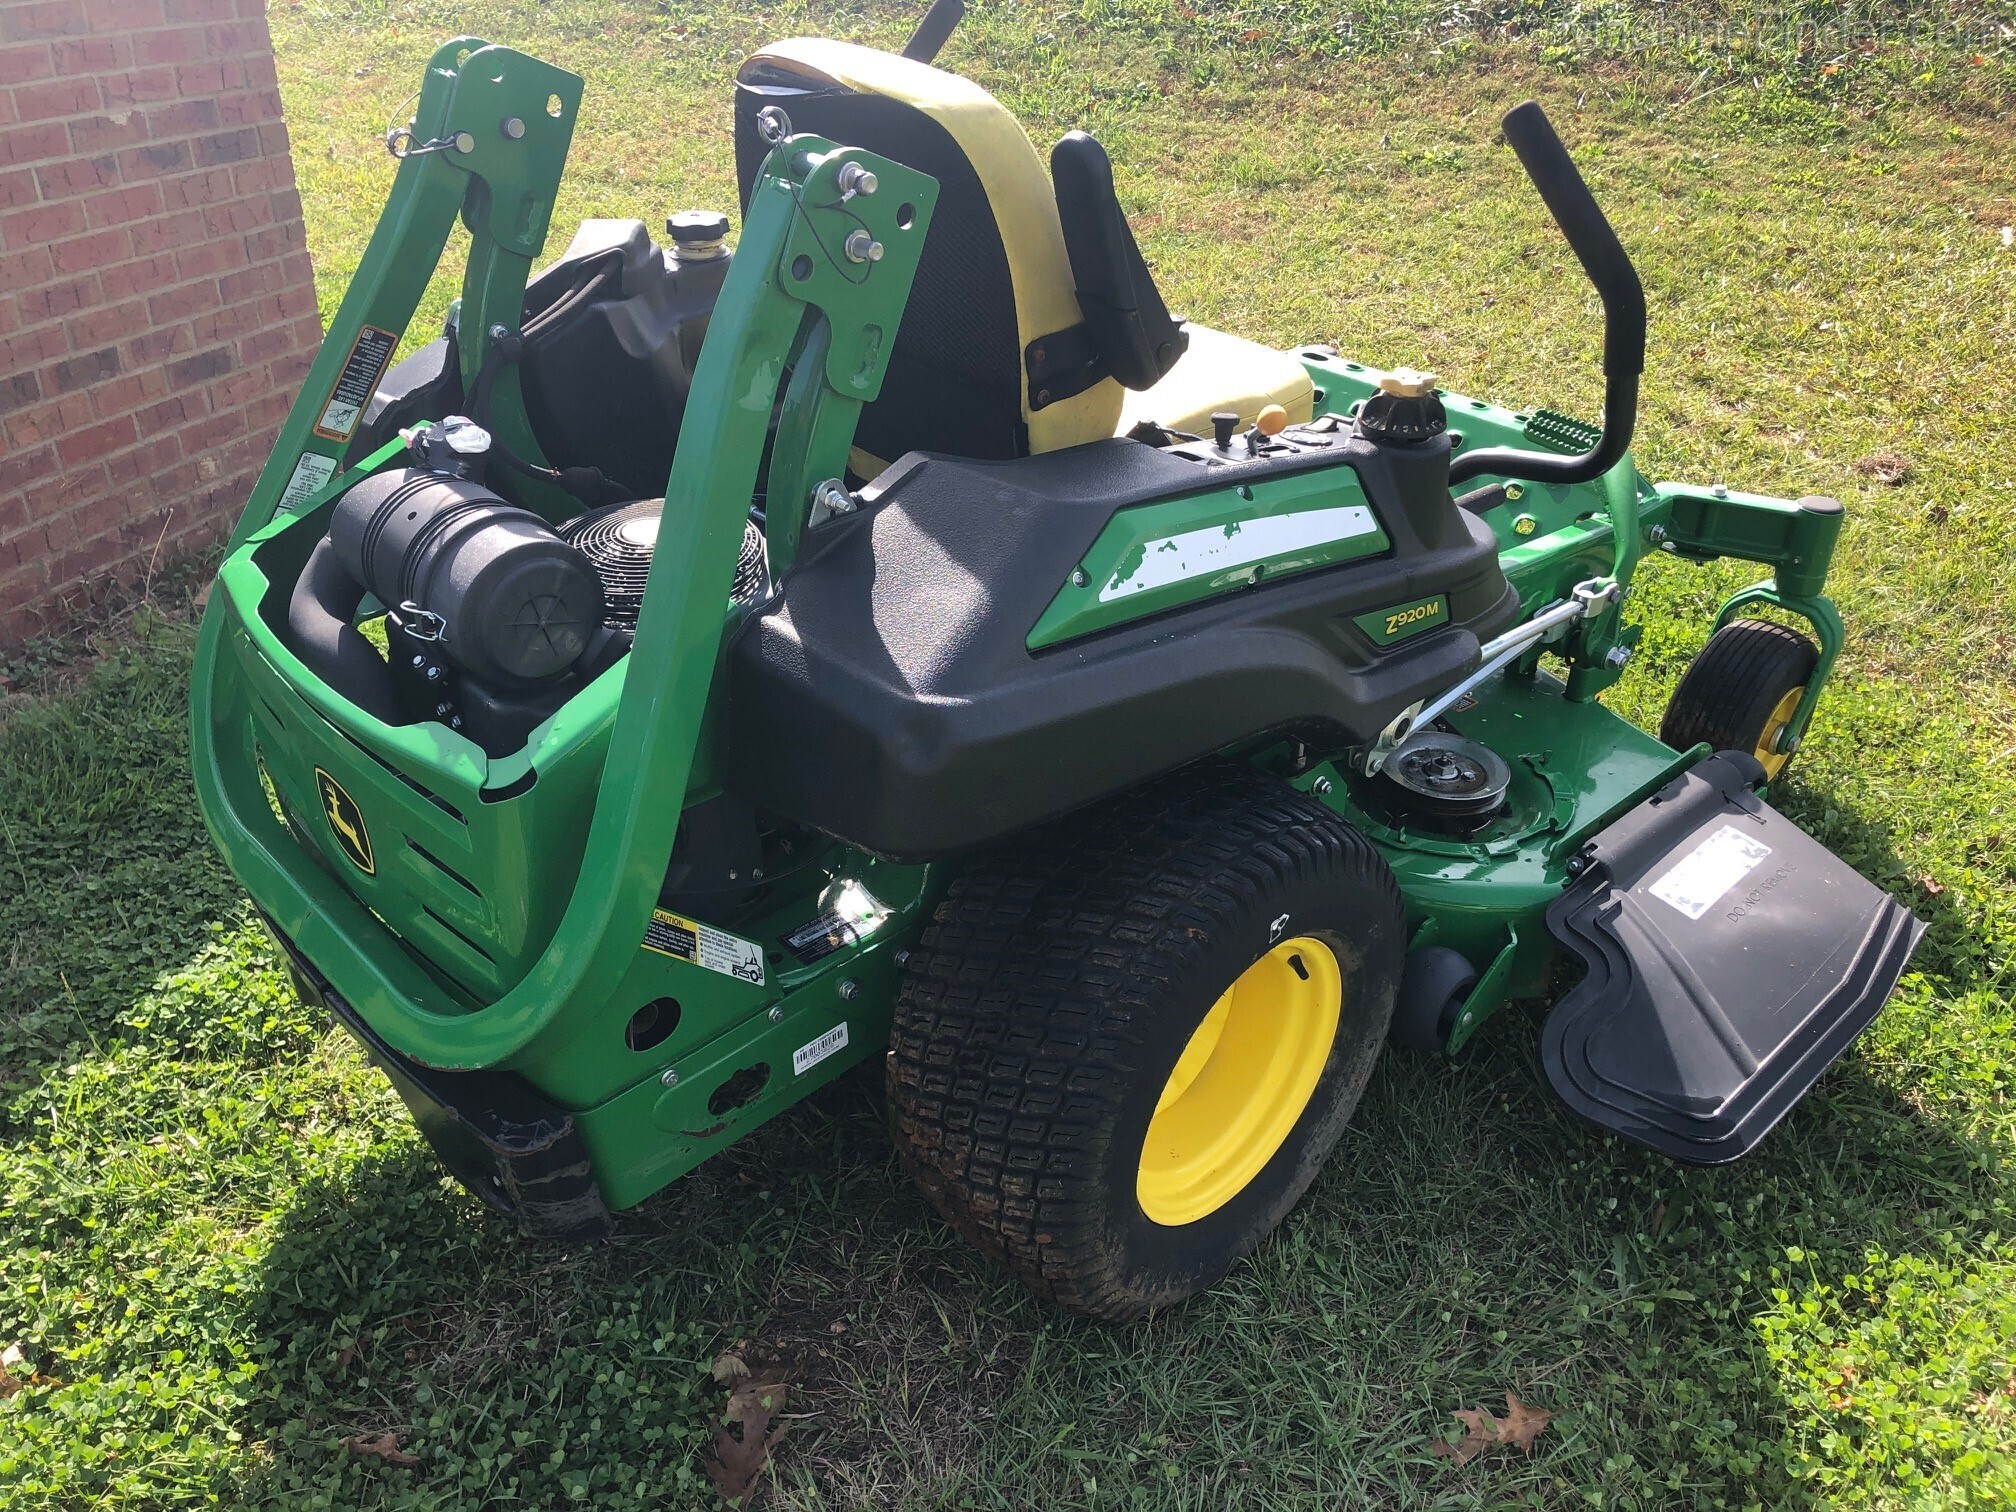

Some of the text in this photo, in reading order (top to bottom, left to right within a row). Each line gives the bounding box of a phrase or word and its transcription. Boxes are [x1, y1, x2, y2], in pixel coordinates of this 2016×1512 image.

[1385, 601, 1439, 635] Z920M
[1726, 862, 1798, 923] DO NOT REMOVE
[654, 911, 684, 928] CAUTION
